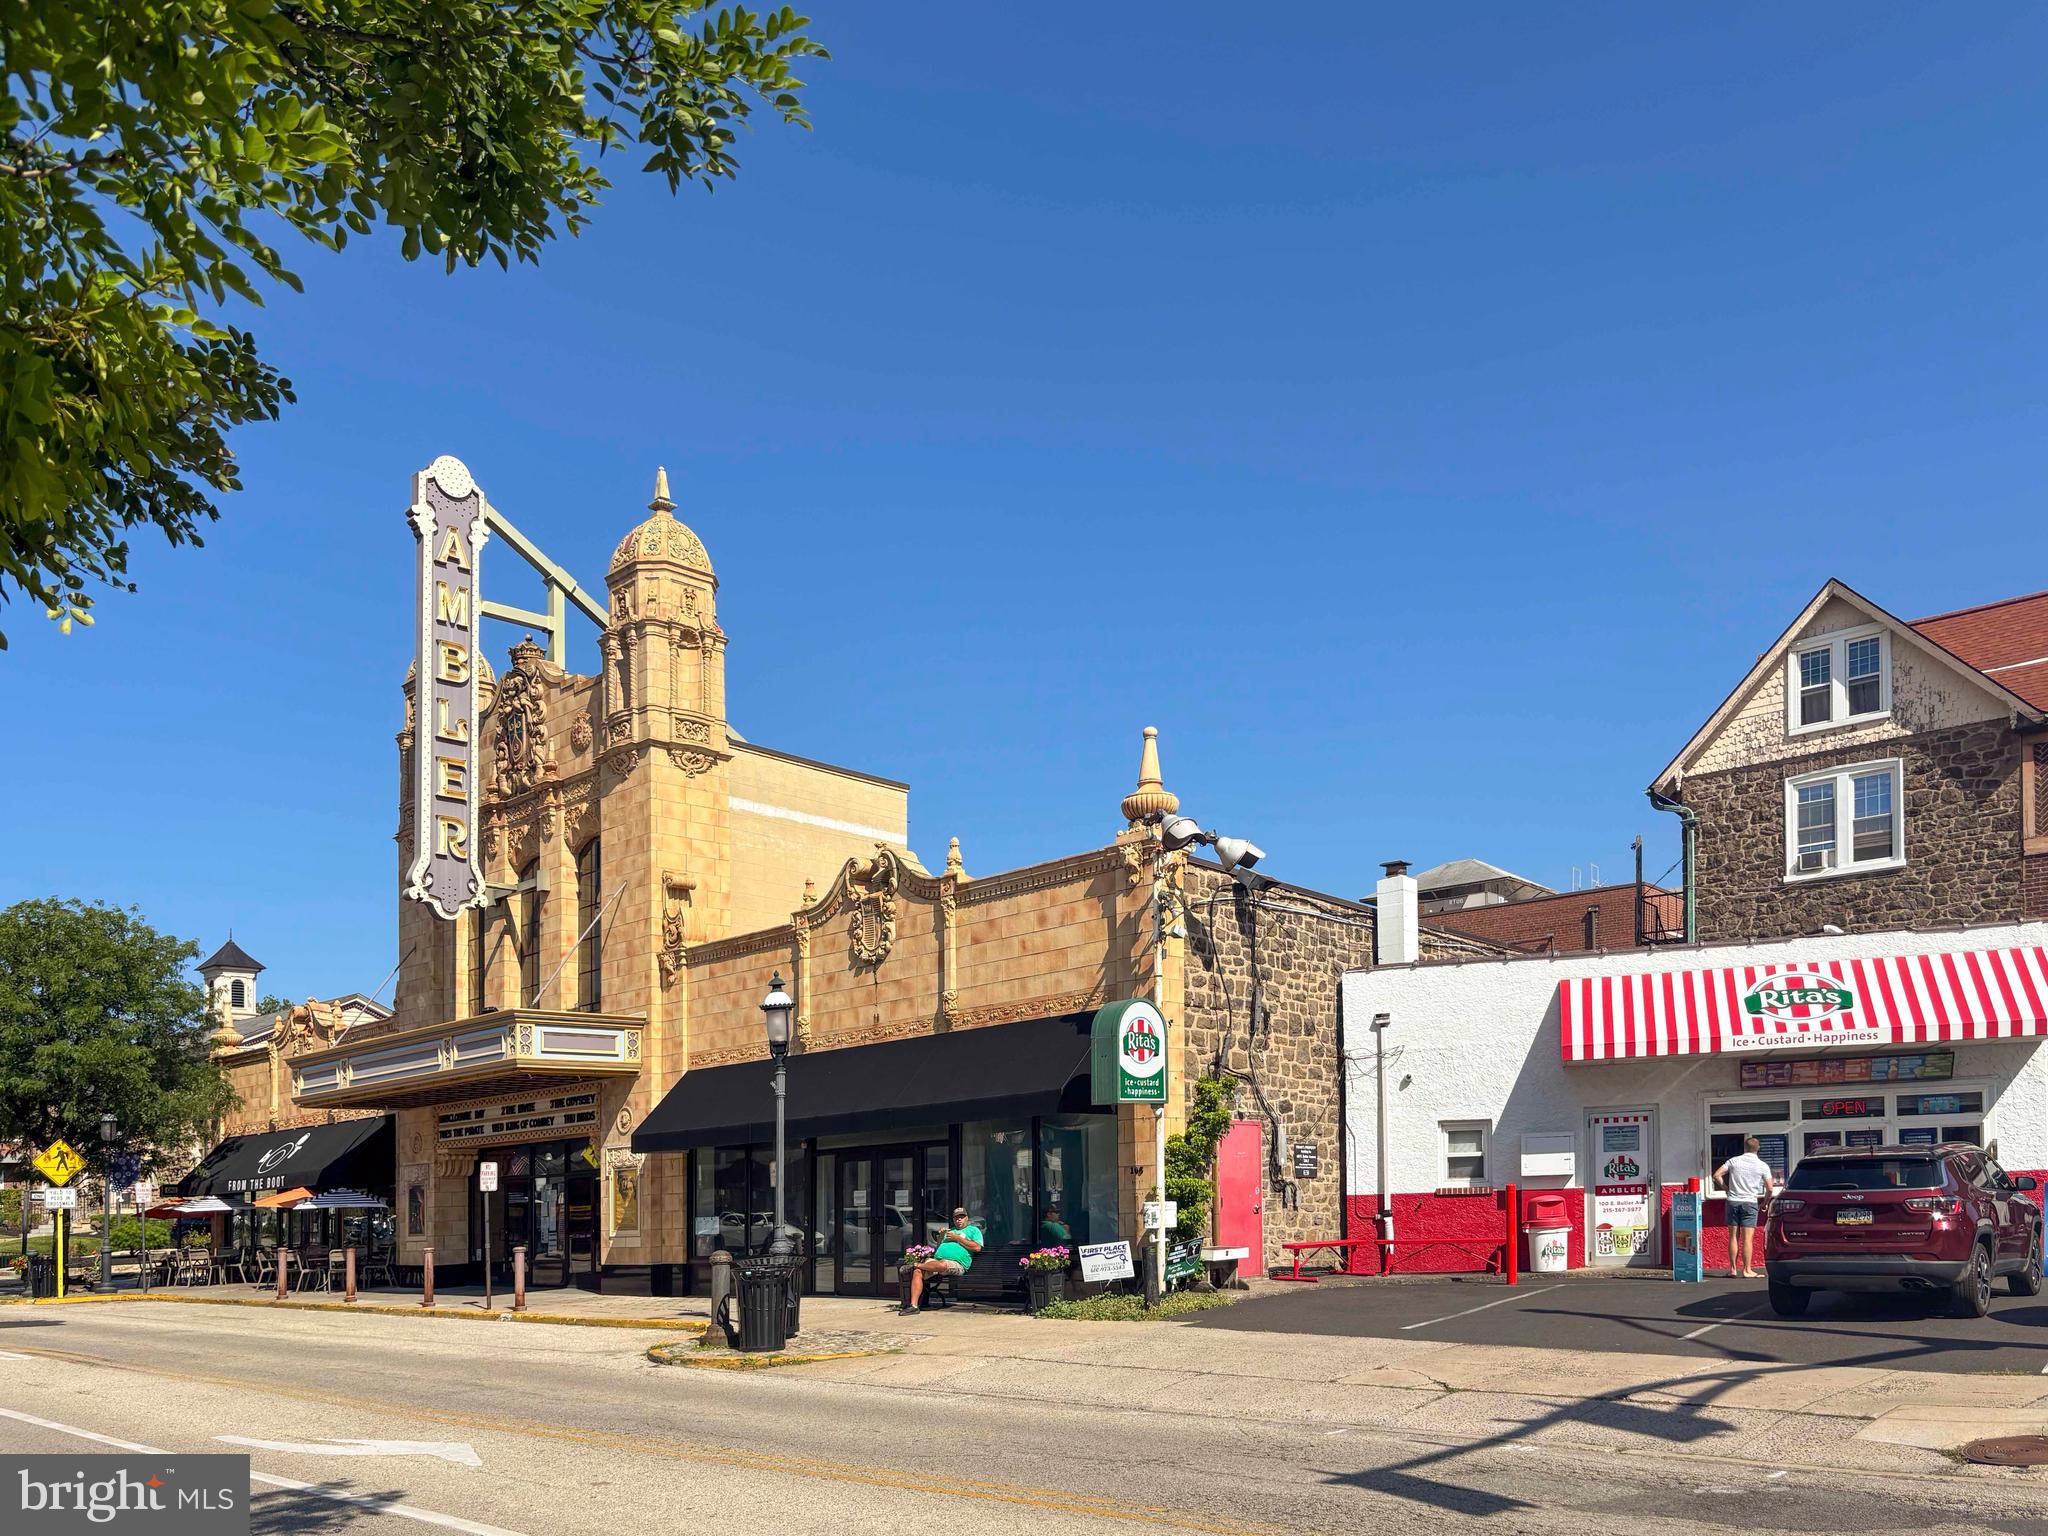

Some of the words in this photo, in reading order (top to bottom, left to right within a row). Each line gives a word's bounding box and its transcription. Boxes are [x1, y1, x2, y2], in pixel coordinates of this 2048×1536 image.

[433, 524, 471, 863] AMBLER
[1758, 988, 1843, 1009] Rita's
[1127, 1031, 1156, 1051] Rita's
[1732, 1038, 1749, 1047] Ice
[1758, 1034, 1805, 1046] Custard
[1813, 1030, 1879, 1045] Happiness
[1137, 1079, 1159, 1087] custard
[1127, 1087, 1157, 1096] happiness
[1822, 1100, 1867, 1116] OPEN
[1608, 1162, 1637, 1174] Rita's
[228, 1179, 247, 1192] FROM
[250, 1178, 264, 1190] THE
[266, 1175, 285, 1189] BOOT
[1601, 1186, 1643, 1194] AMBLER
[1083, 1246, 1104, 1254] FIRST
[1104, 1244, 1127, 1252] PLACE
